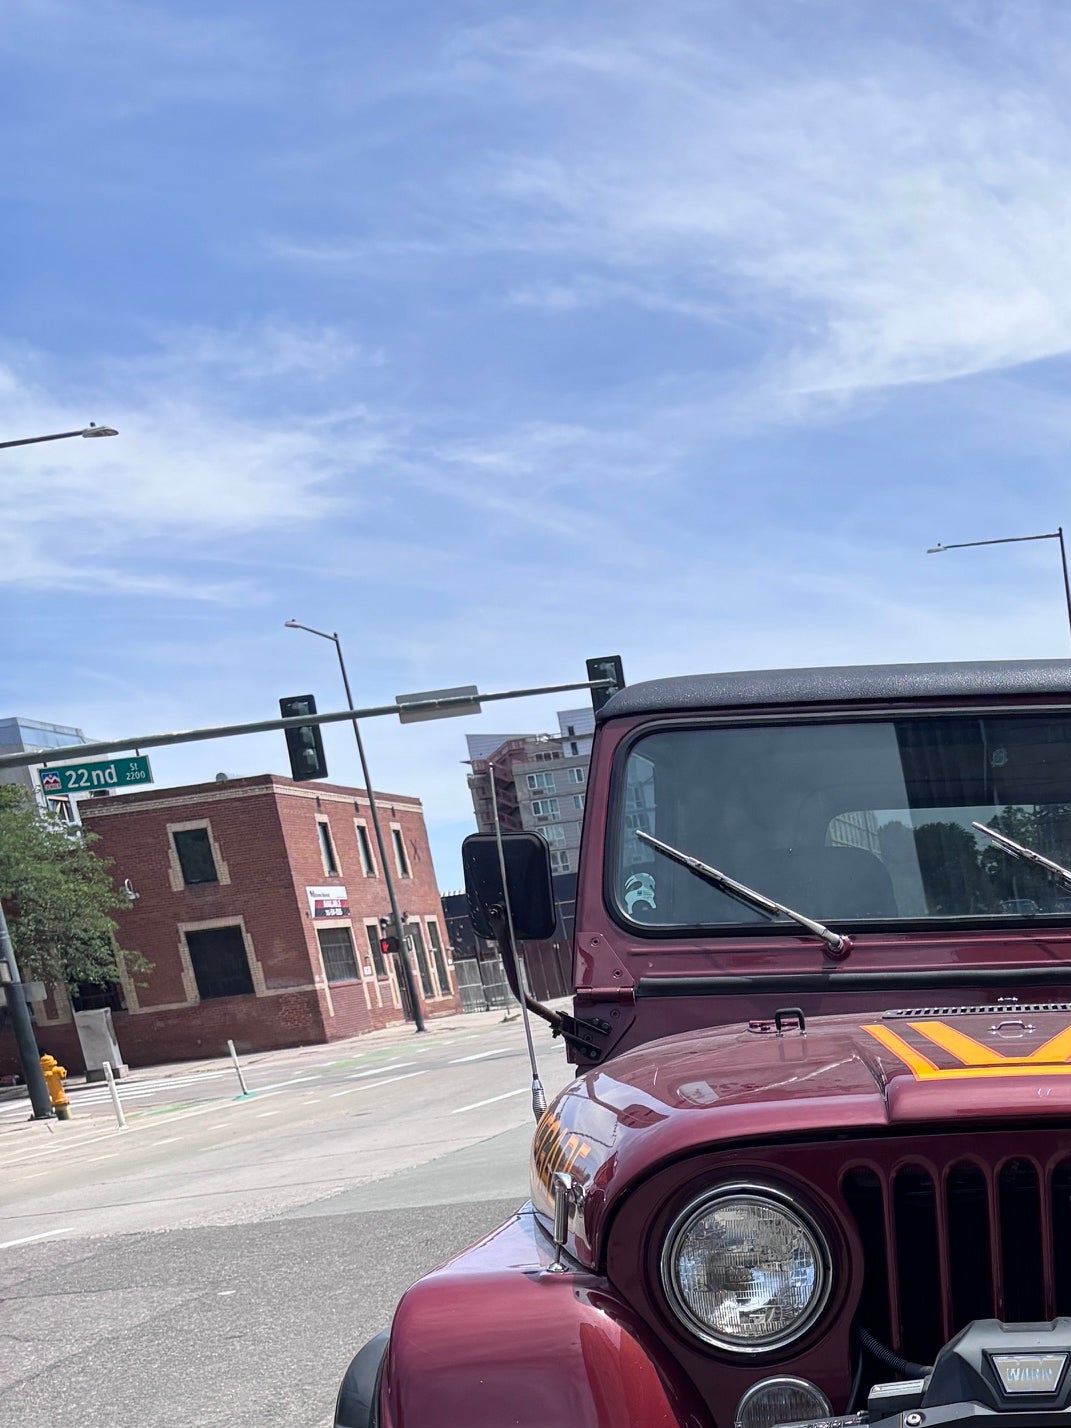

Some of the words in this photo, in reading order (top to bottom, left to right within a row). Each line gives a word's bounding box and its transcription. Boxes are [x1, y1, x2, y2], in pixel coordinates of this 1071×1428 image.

[130, 762, 138, 771] St
[65, 764, 118, 789] 22nd
[126, 770, 146, 781] 2200
[1006, 1368, 1054, 1381] WARN
